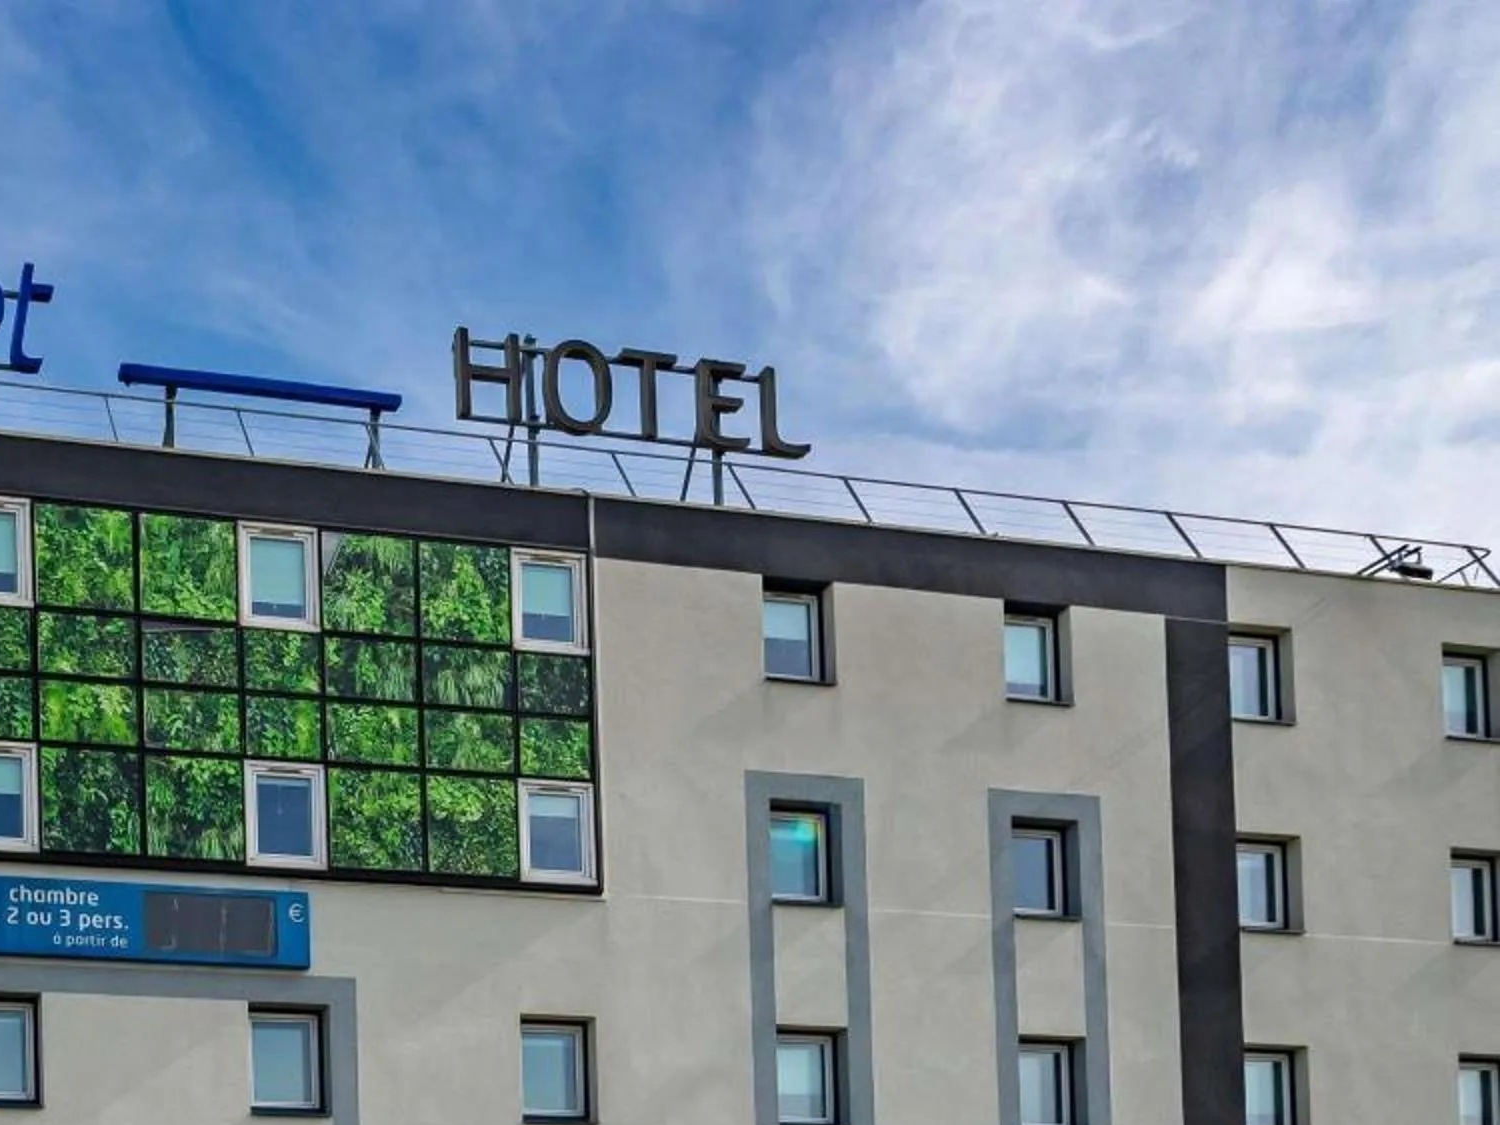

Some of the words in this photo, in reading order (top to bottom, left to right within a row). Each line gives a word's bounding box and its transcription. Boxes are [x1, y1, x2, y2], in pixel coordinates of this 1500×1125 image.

[453, 326, 811, 460] HOTEL
[9, 885, 99, 906] chambre
[7, 907, 19, 925] 2
[27, 911, 52, 926] ou
[59, 909, 71, 927] 3
[79, 912, 129, 931] pers.
[289, 903, 304, 922] €
[66, 935, 105, 947] partir
[111, 936, 129, 949] de
